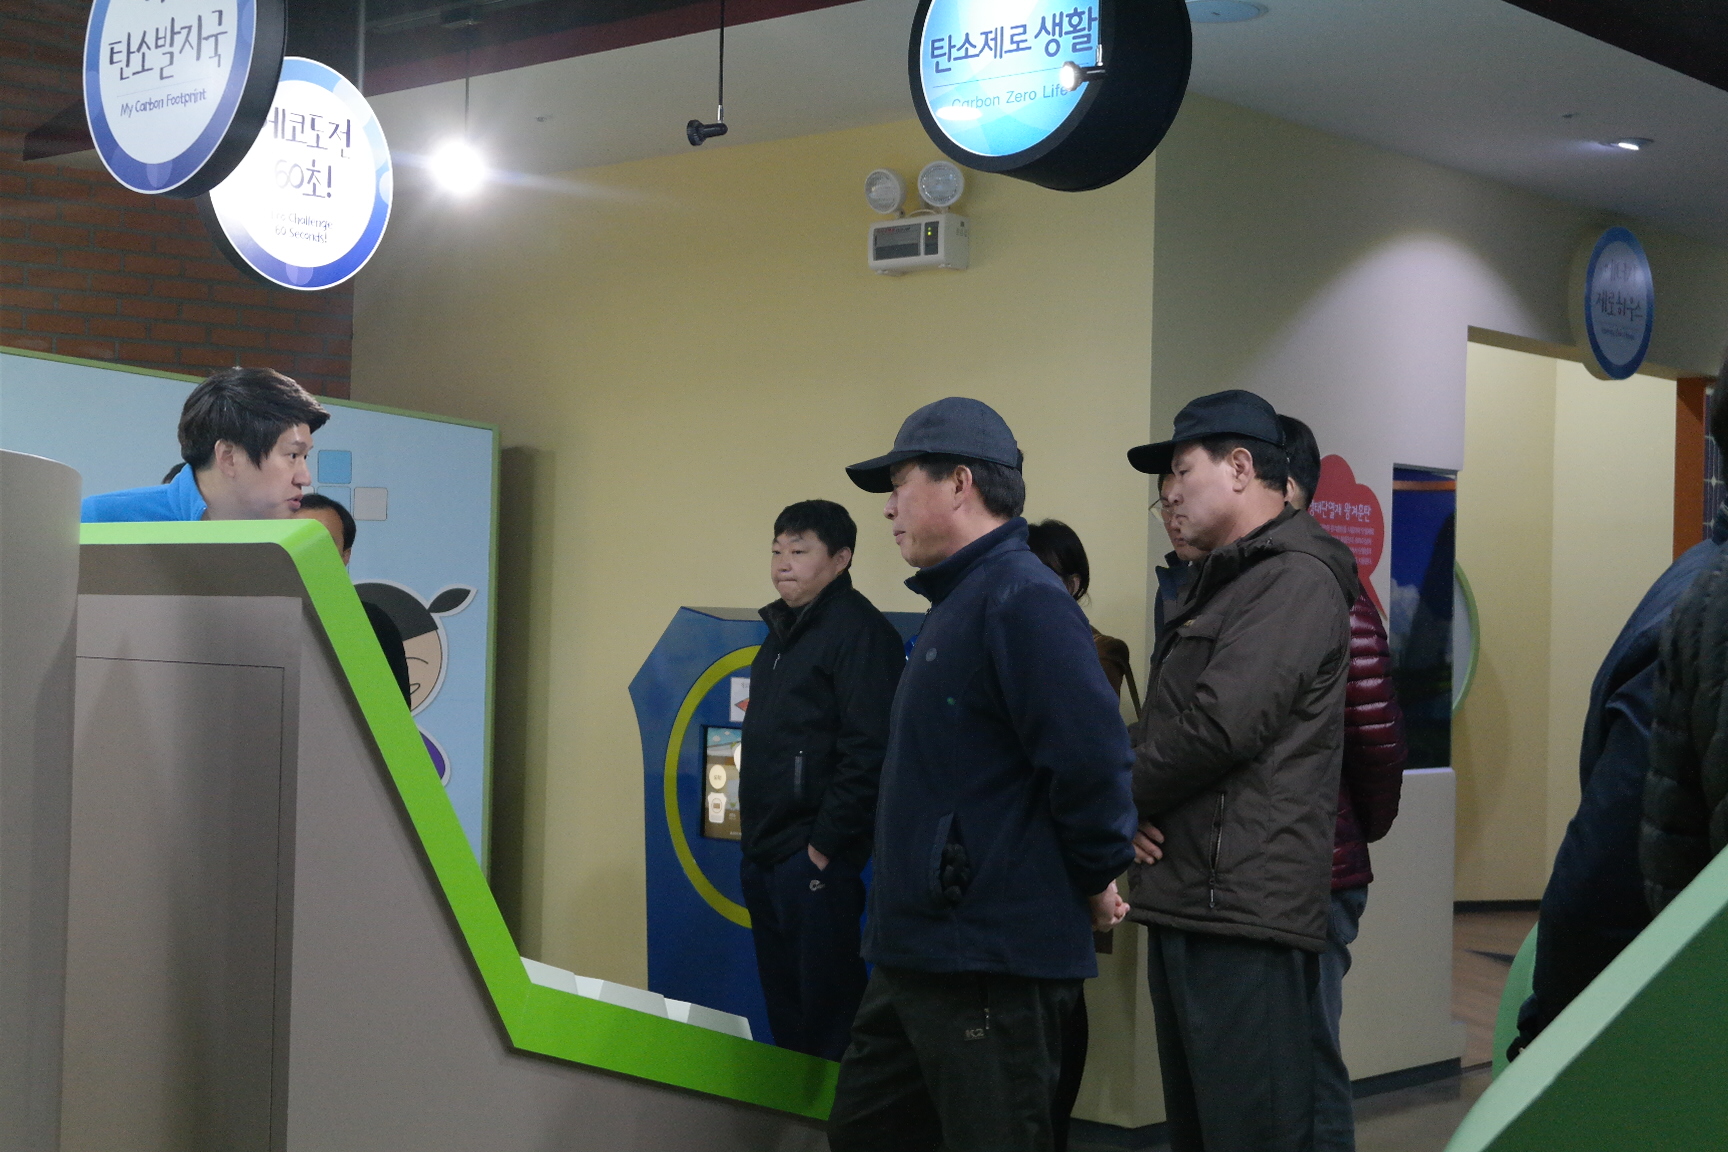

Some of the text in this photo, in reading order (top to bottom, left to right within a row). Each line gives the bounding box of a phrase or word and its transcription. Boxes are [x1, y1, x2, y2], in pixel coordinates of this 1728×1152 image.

[120, 88, 207, 118] My Carbon Footprint
[951, 83, 1069, 109] Carbon Zero Life
[274, 159, 332, 198] 60초!
[274, 224, 328, 244] 60 Seconds!
[288, 212, 333, 232] Challenge
[1595, 290, 1643, 321] 제로하우스
